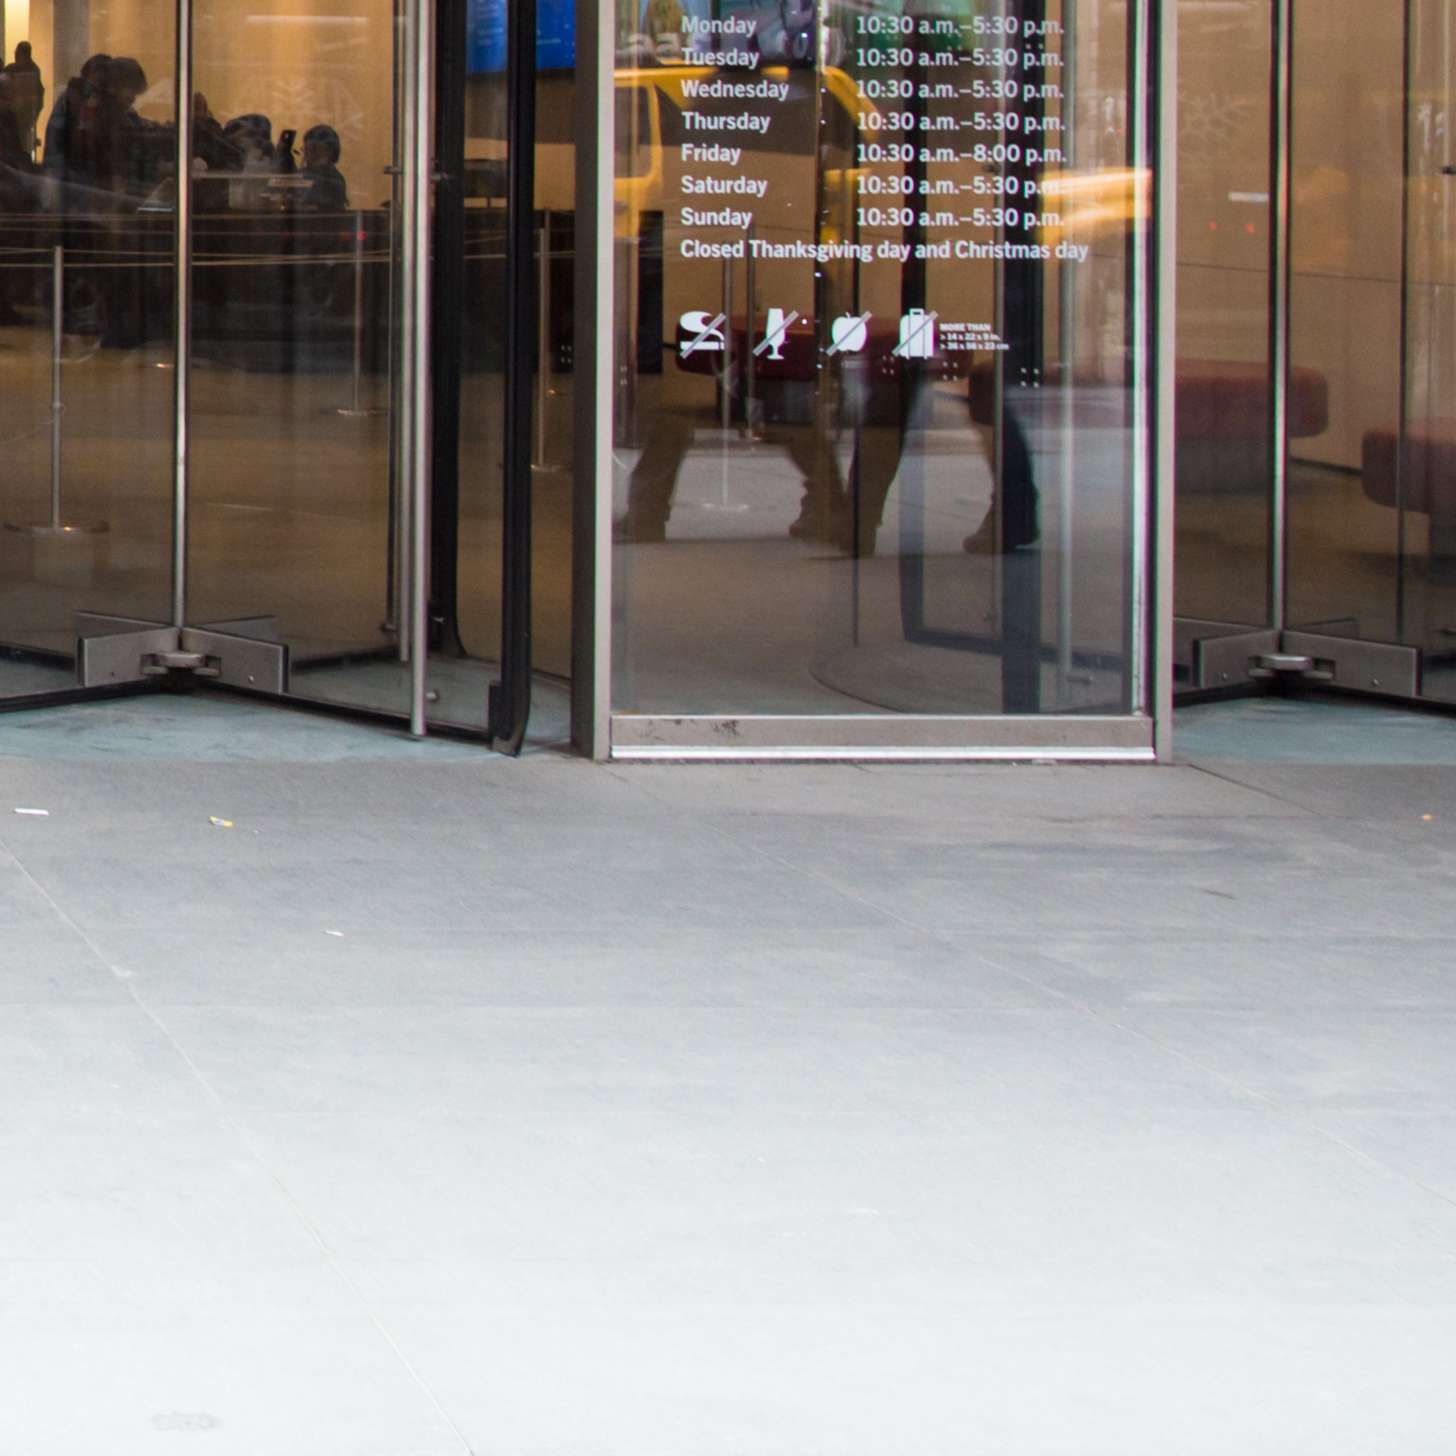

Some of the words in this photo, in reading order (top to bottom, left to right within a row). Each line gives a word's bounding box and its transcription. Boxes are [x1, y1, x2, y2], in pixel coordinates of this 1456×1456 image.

[681, 16, 757, 38] Monday
[857, 16, 913, 35] 10:30
[918, 16, 1018, 35] a.m.–5:30
[1024, 20, 1065, 37] p.m.
[681, 48, 760, 70] Tuesday
[857, 48, 913, 67] 10:30
[918, 48, 1018, 67] a.m.–5:30
[1024, 52, 1065, 69] p.m.
[681, 80, 789, 102] Wednesday
[857, 80, 913, 99] 10:30
[918, 80, 1018, 99] a.m.–5:30
[1024, 84, 1065, 101] p.m.
[681, 112, 770, 134] Thursday
[857, 112, 914, 131] 10:30
[919, 112, 1018, 131] a.m.–5:30
[1024, 116, 1066, 133] p.m.
[681, 144, 741, 166] Friday
[857, 144, 914, 163] 10:30
[919, 144, 1020, 163] a.m.–8:00
[1024, 148, 1066, 165] p.m.
[681, 176, 768, 198] Saturday
[857, 176, 914, 195] 10:30
[919, 176, 1018, 195] a.m.–5:30
[681, 208, 753, 230] Sunday
[857, 208, 914, 227] 10:30
[919, 208, 1018, 227] a.m.–5:30
[1024, 212, 1066, 229] p.m.
[680, 240, 744, 259] Closed
[749, 240, 872, 262] Thanksgiving
[877, 240, 910, 262] day
[914, 240, 950, 259] and
[955, 240, 1050, 259] Christmas
[1056, 240, 1089, 262] day
